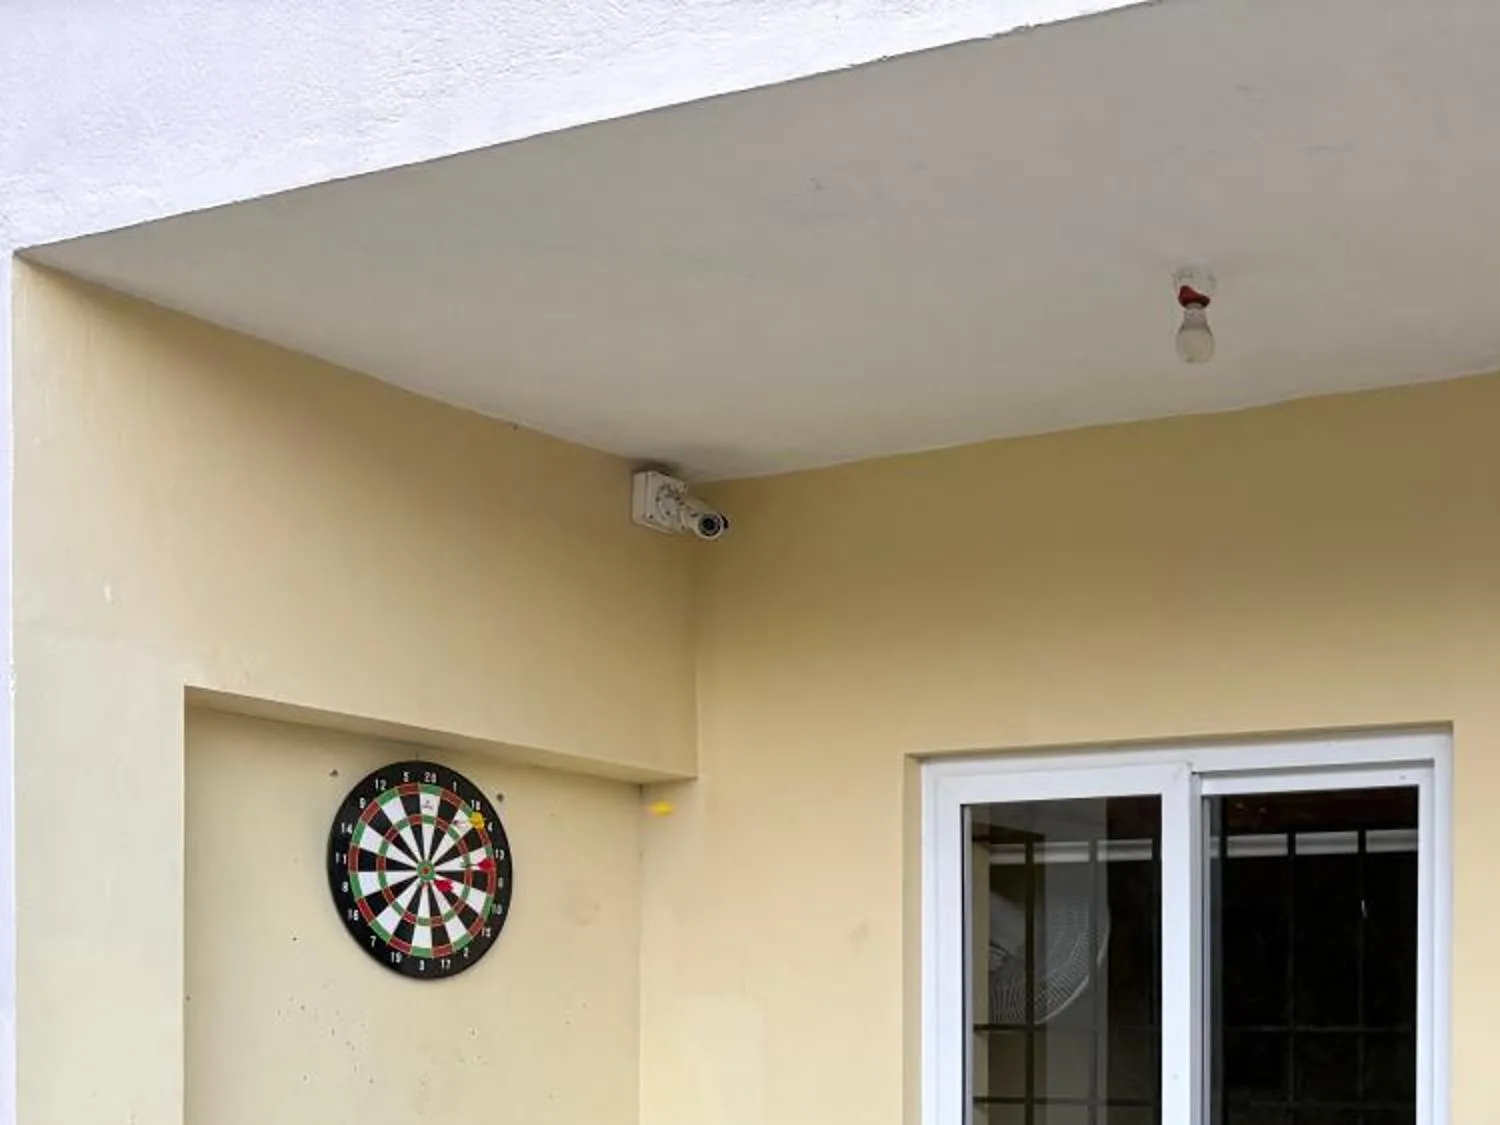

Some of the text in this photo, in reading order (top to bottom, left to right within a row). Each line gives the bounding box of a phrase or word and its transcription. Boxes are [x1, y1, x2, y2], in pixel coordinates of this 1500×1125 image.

[375, 778, 387, 791] 12
[341, 821, 353, 834] 14
[335, 852, 347, 865] 11
[370, 936, 376, 947] 7
